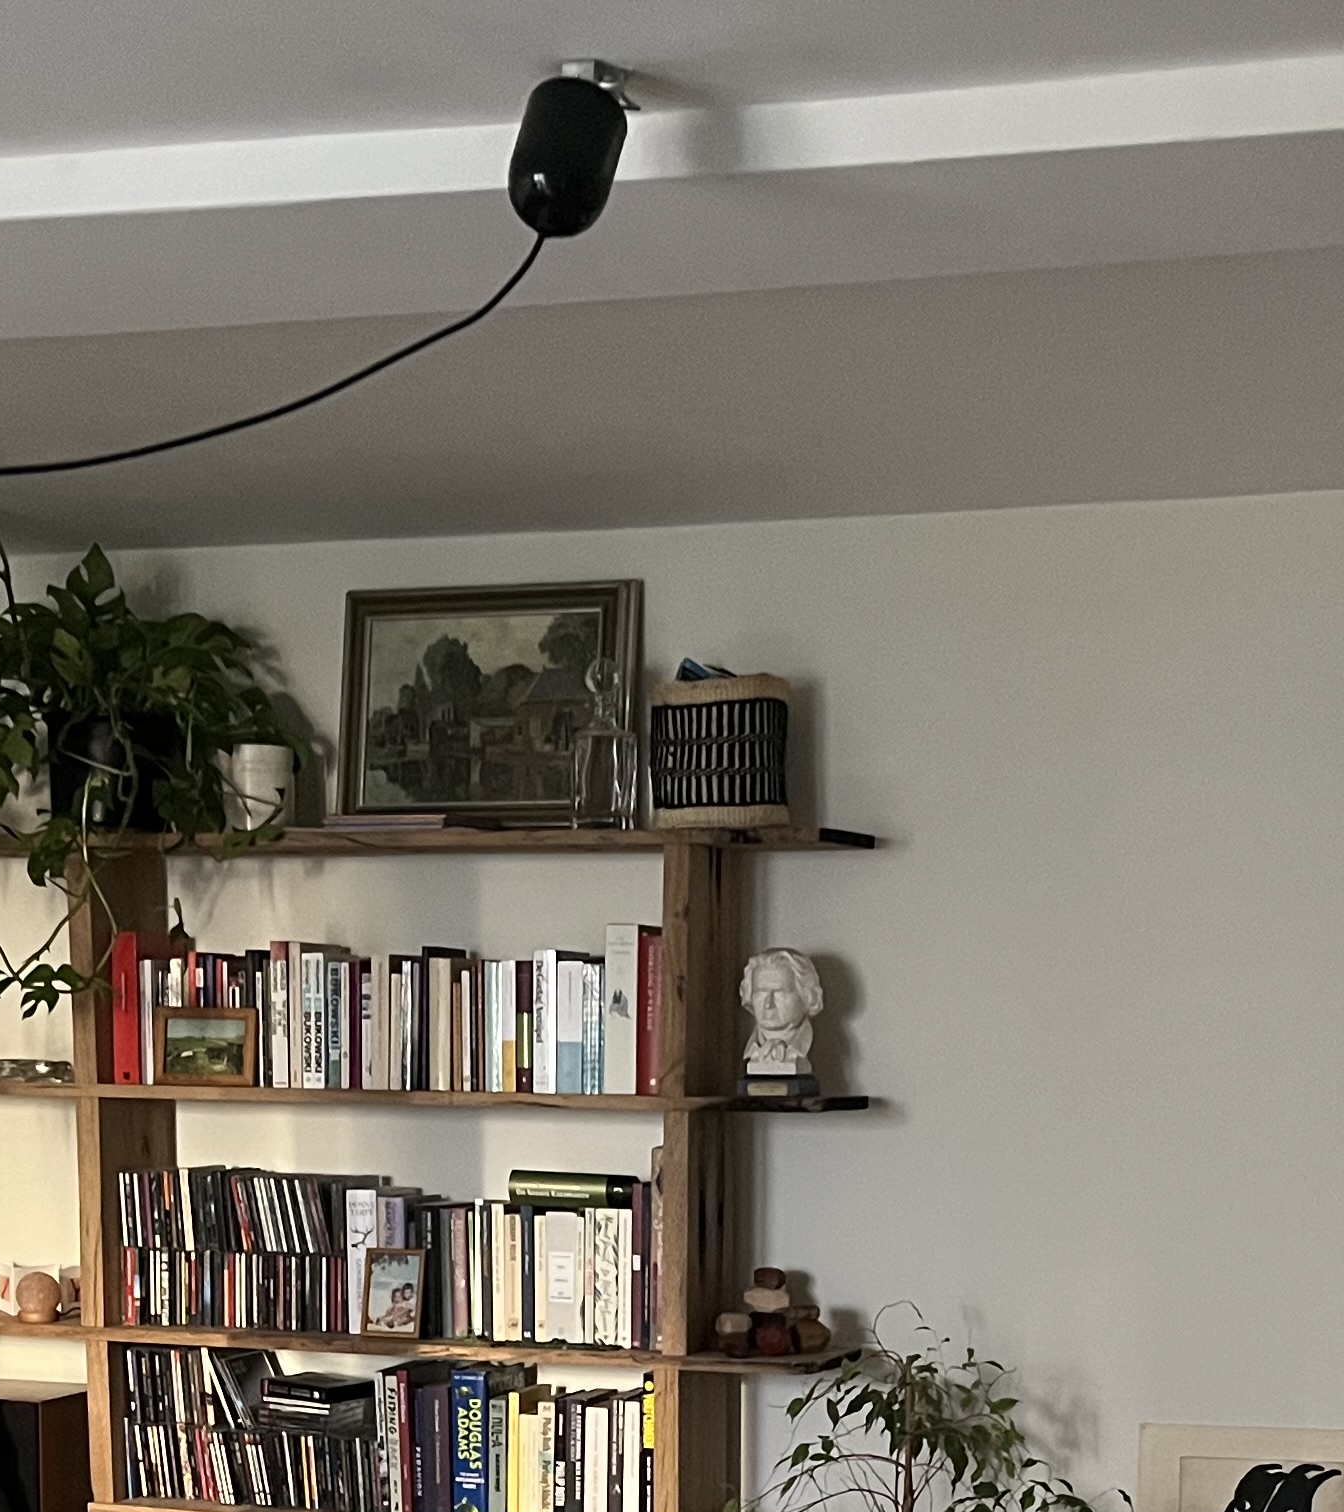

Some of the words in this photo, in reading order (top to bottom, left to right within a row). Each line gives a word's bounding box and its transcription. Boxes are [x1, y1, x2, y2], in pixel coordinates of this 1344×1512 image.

[330, 967, 339, 1045] BUKOWSKI
[304, 1011, 312, 1073] BUKOWSKI
[314, 1011, 323, 1073] BUKOWSKI
[457, 1407, 470, 1460] ADAMS
[468, 1398, 482, 1470] DOUGLAS
